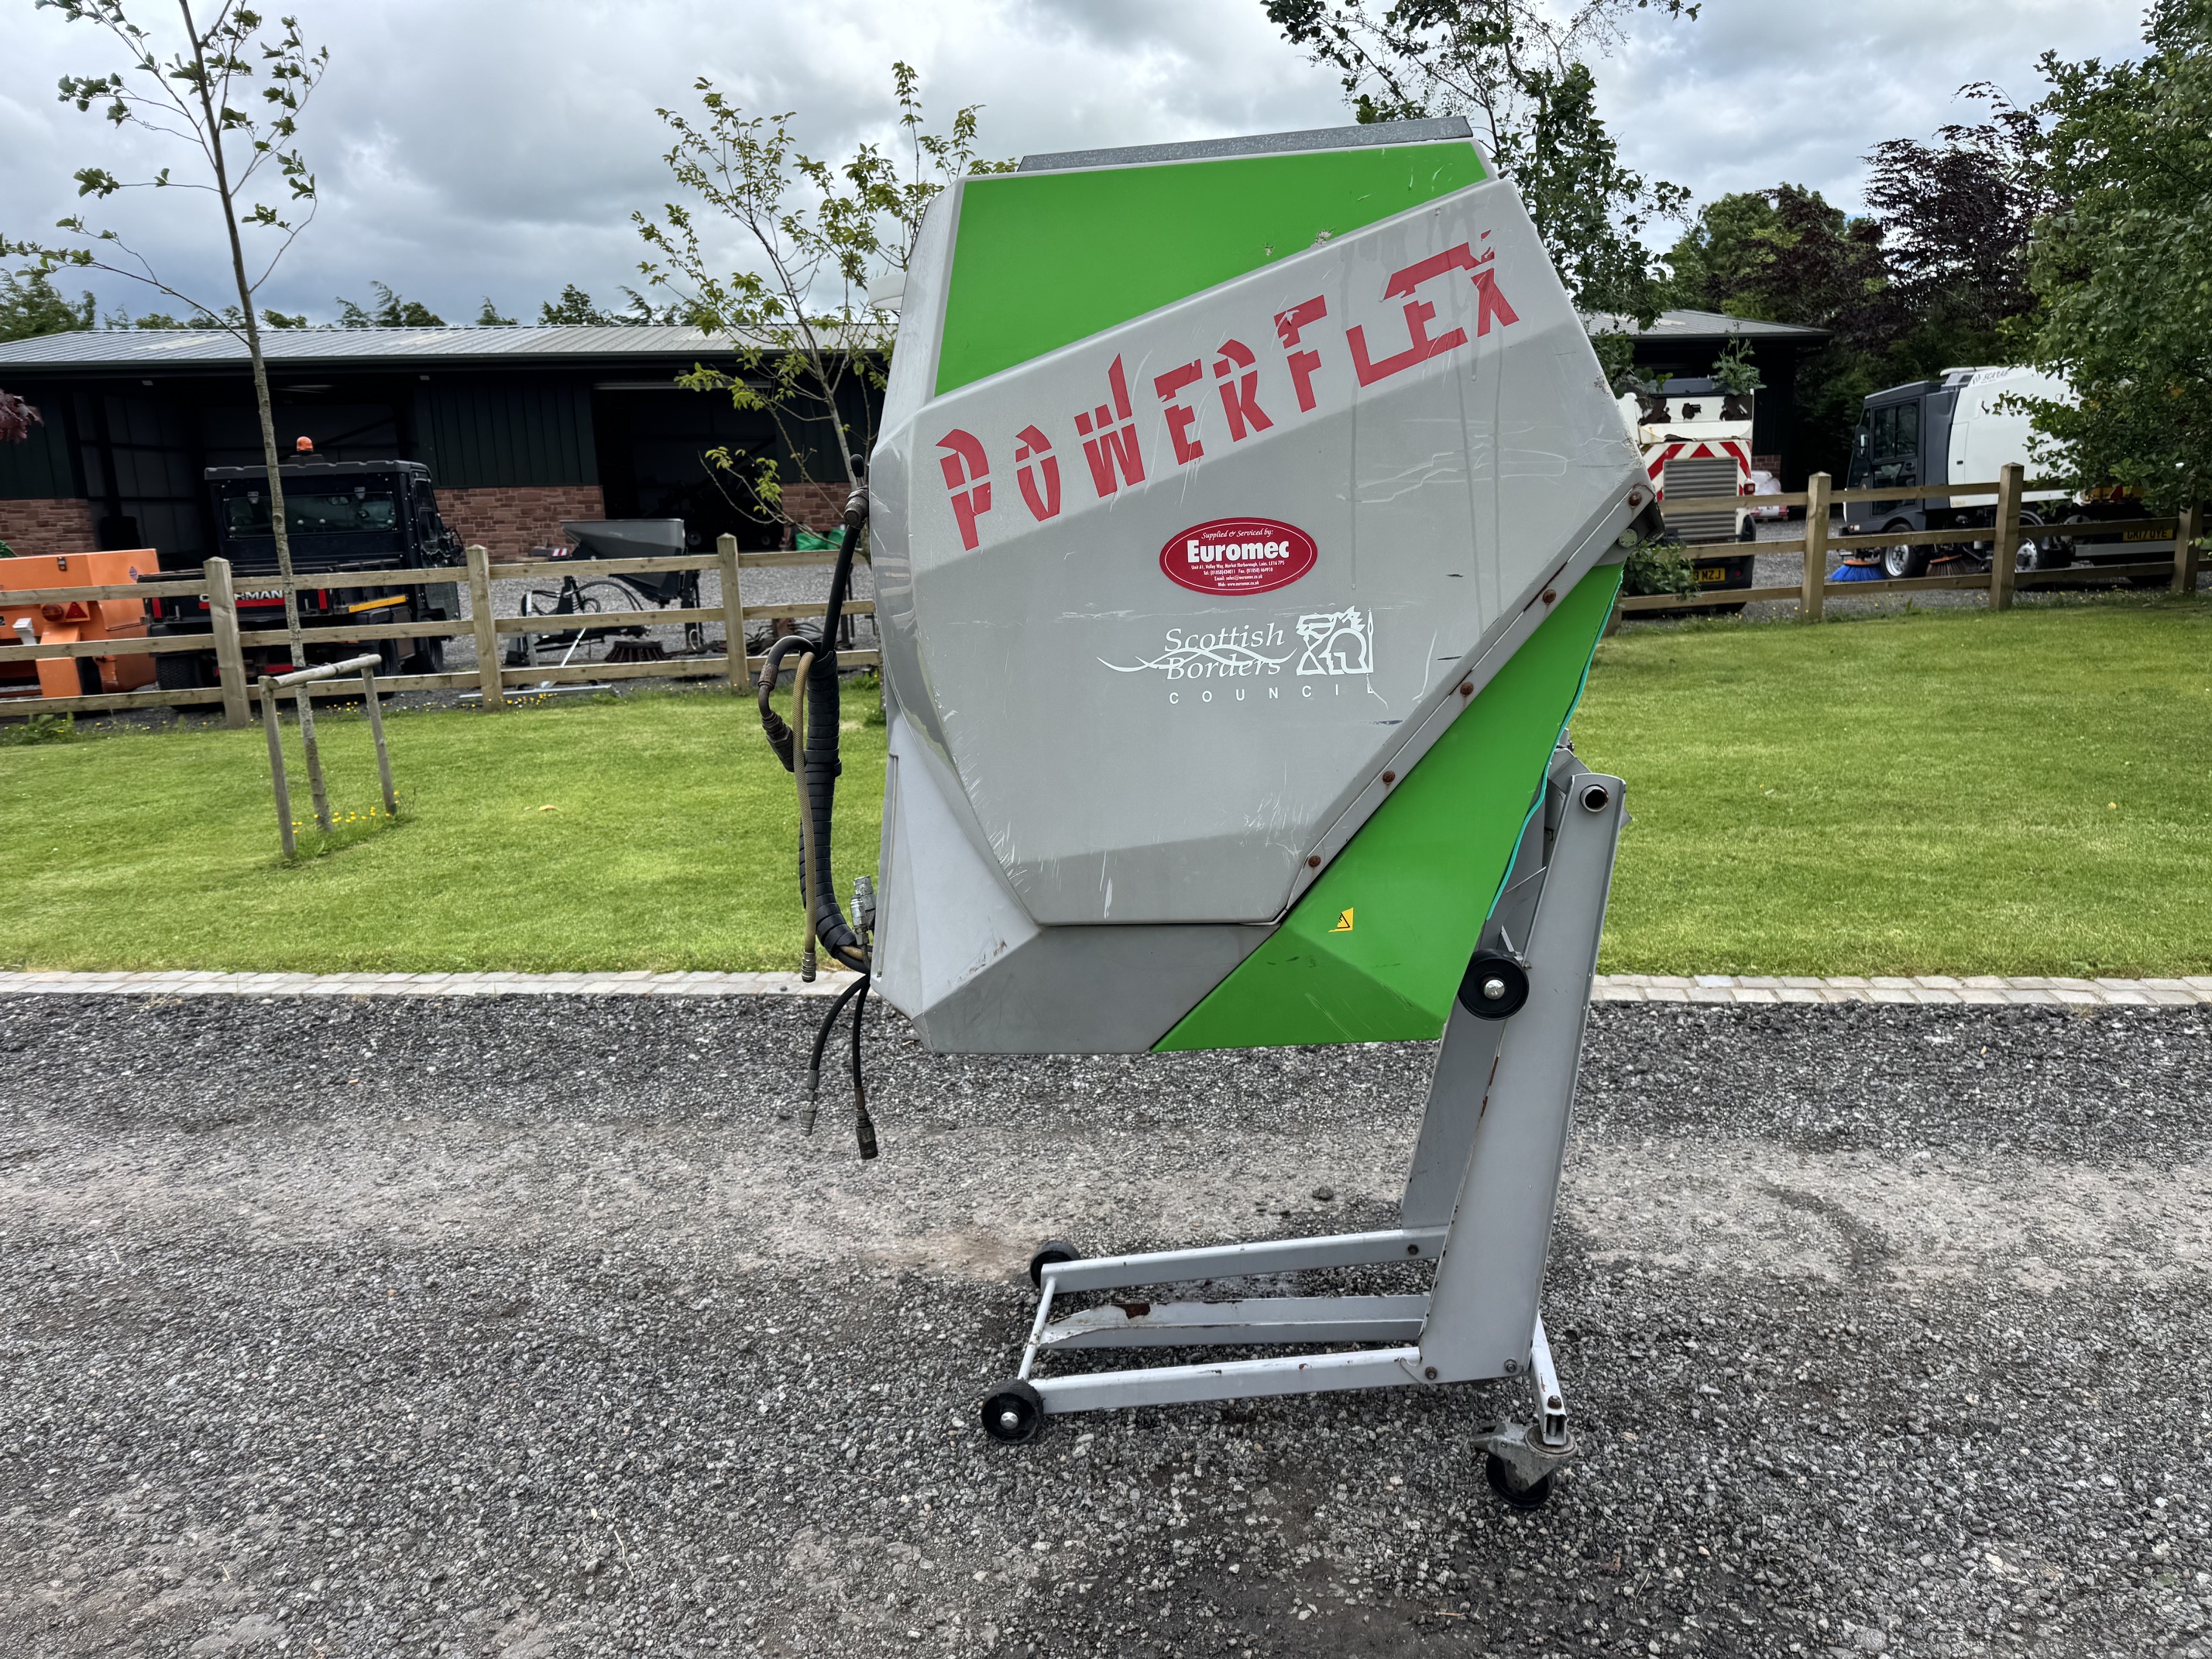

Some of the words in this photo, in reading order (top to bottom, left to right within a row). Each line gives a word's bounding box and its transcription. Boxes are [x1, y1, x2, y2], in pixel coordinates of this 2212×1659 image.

[936, 229, 1520, 551] POWERFLEX
[1201, 530, 1228, 540] Supplied
[1236, 527, 1264, 538] Serviced
[1264, 527, 1274, 538] by:
[1187, 540, 1289, 562] Euromec
[1701, 569, 1721, 581] MZJ
[200, 589, 283, 602] CHMAN
[1163, 622, 1286, 652] Scottish
[1165, 654, 1282, 680] Borders
[1168, 683, 1375, 705] COUNCIL
